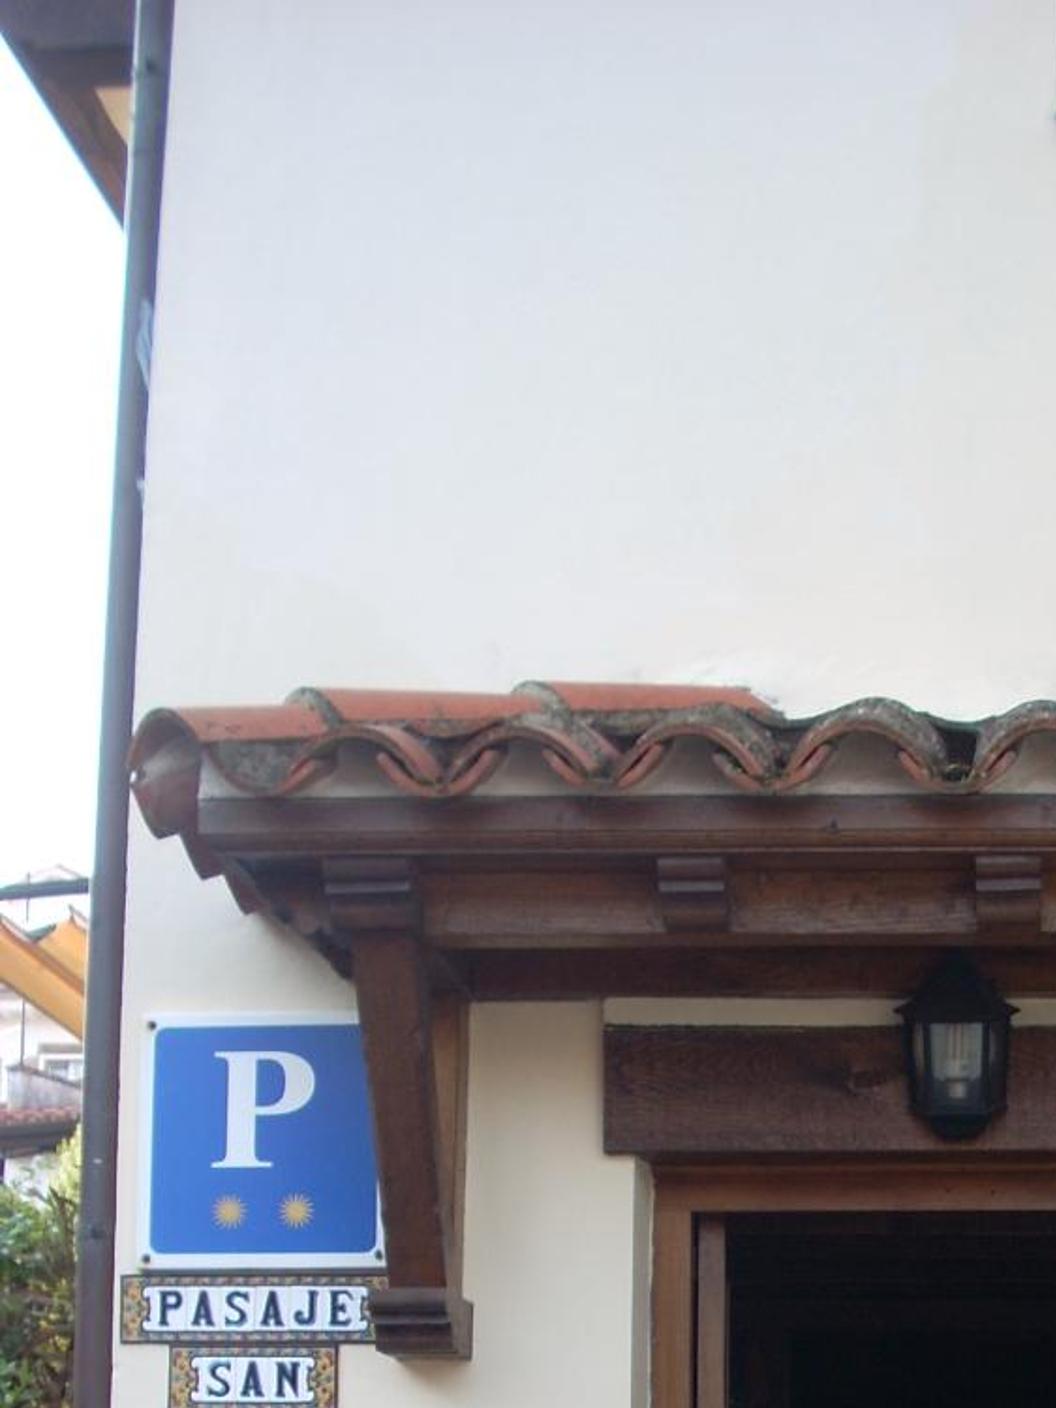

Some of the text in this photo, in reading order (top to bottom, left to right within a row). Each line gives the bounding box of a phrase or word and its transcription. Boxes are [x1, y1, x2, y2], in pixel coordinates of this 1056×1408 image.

[211, 1050, 316, 1169] P
[157, 1290, 356, 1328] PASAJE
[206, 1360, 300, 1398] SAN
